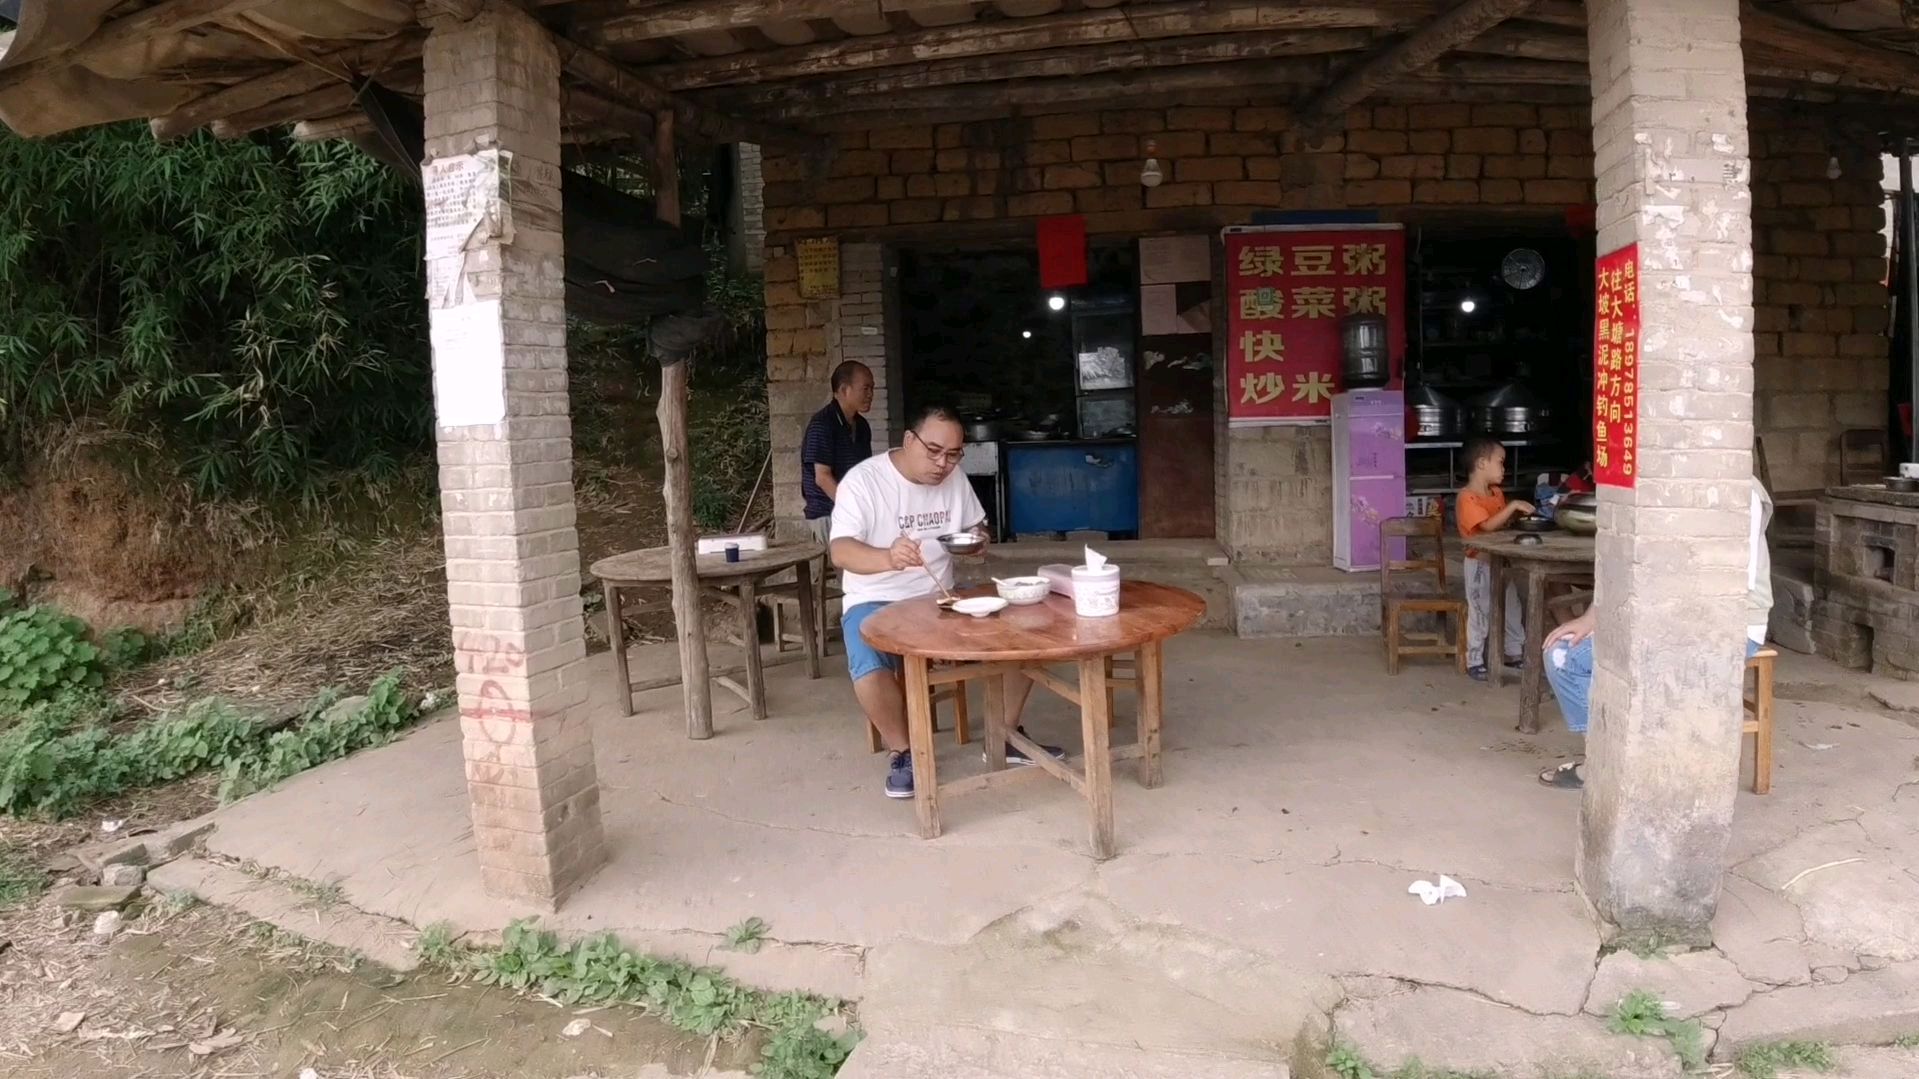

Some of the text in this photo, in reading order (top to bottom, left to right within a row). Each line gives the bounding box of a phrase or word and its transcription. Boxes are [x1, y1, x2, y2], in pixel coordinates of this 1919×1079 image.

[1239, 243, 1386, 277] 绿豆粥
[1239, 286, 1387, 320] 酸菜粥
[1239, 330, 1285, 363] 快
[1610, 268, 1623, 424] 往大塘路方向
[1596, 267, 1610, 469] 大坡黑泥冲钓鱼场
[1239, 371, 1335, 404] 炒米
